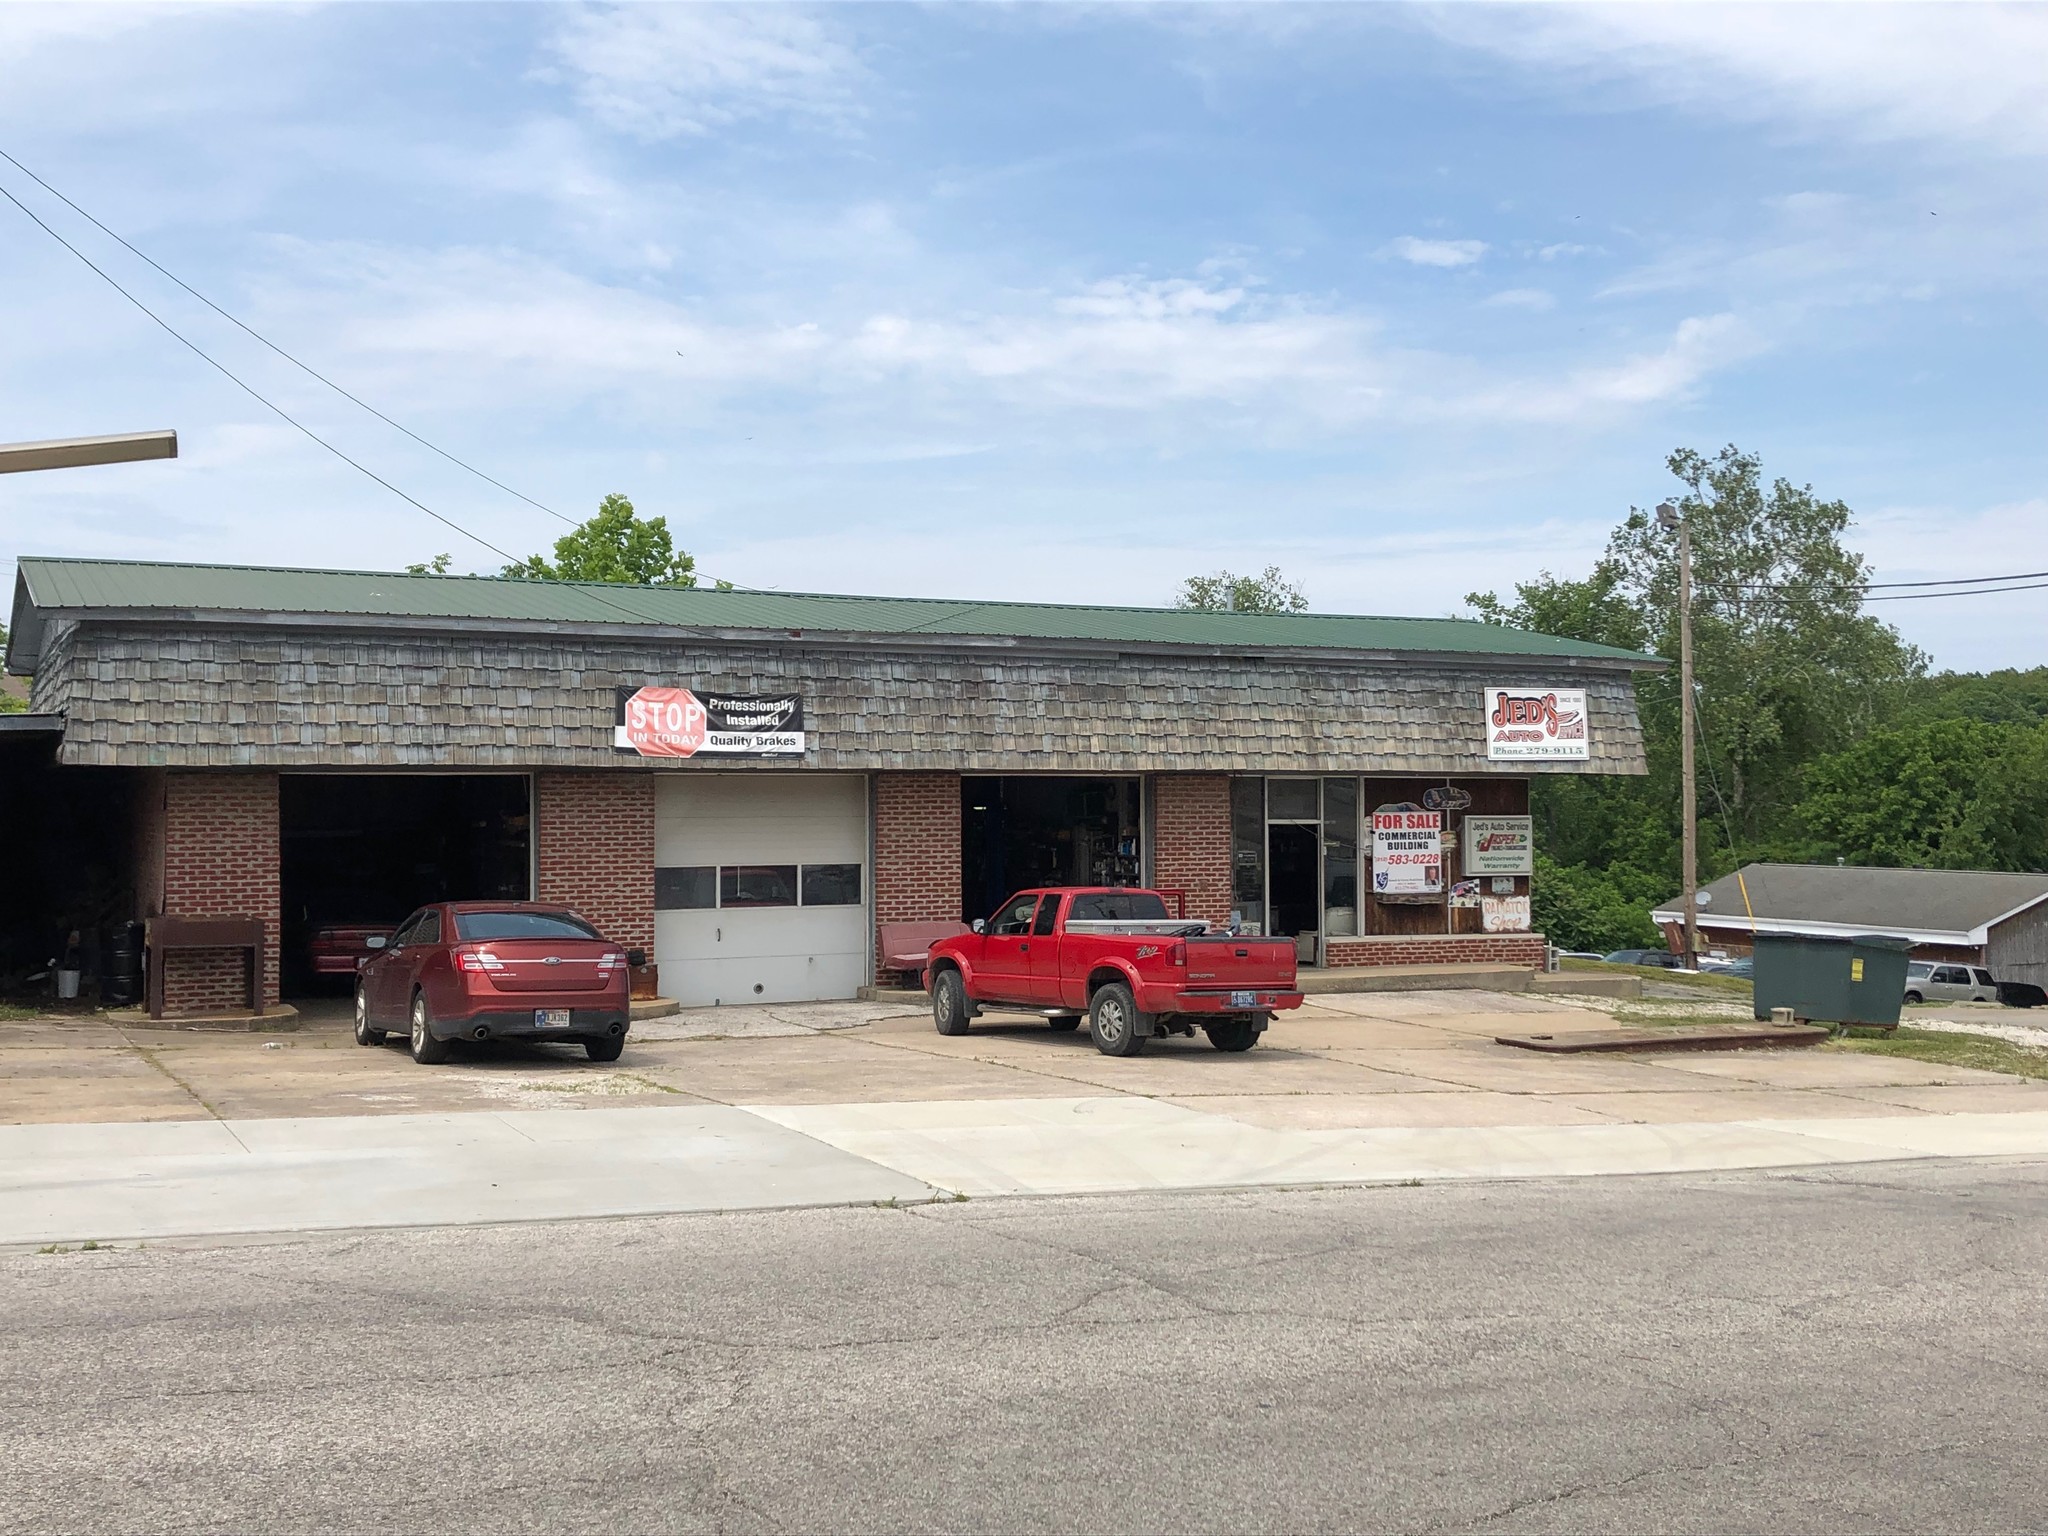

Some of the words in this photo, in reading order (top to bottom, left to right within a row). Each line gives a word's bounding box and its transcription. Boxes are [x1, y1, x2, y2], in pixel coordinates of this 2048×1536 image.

[709, 698, 795, 713] Professionally
[631, 699, 701, 732] STOP
[726, 714, 779, 726] Installed
[1492, 692, 1558, 737] JED'S
[633, 731, 648, 742] IN
[653, 732, 699, 746] TODAY
[710, 735, 752, 747] Quality
[756, 736, 796, 746] Brakes
[1493, 730, 1545, 742] AUTO
[1495, 747, 1523, 755] Phone
[1526, 747, 1582, 755] 279-9115
[1374, 814, 1403, 830] FOR
[1406, 813, 1440, 829] SALE
[1472, 821, 1489, 831] Jed's
[1490, 821, 1505, 831] Auto
[1506, 821, 1529, 831] Service
[1378, 831, 1437, 841] COMMERCIAL
[1387, 841, 1429, 851] BUILDING
[1388, 854, 1439, 865] 583-0228
[1490, 915, 1522, 932] Shop
